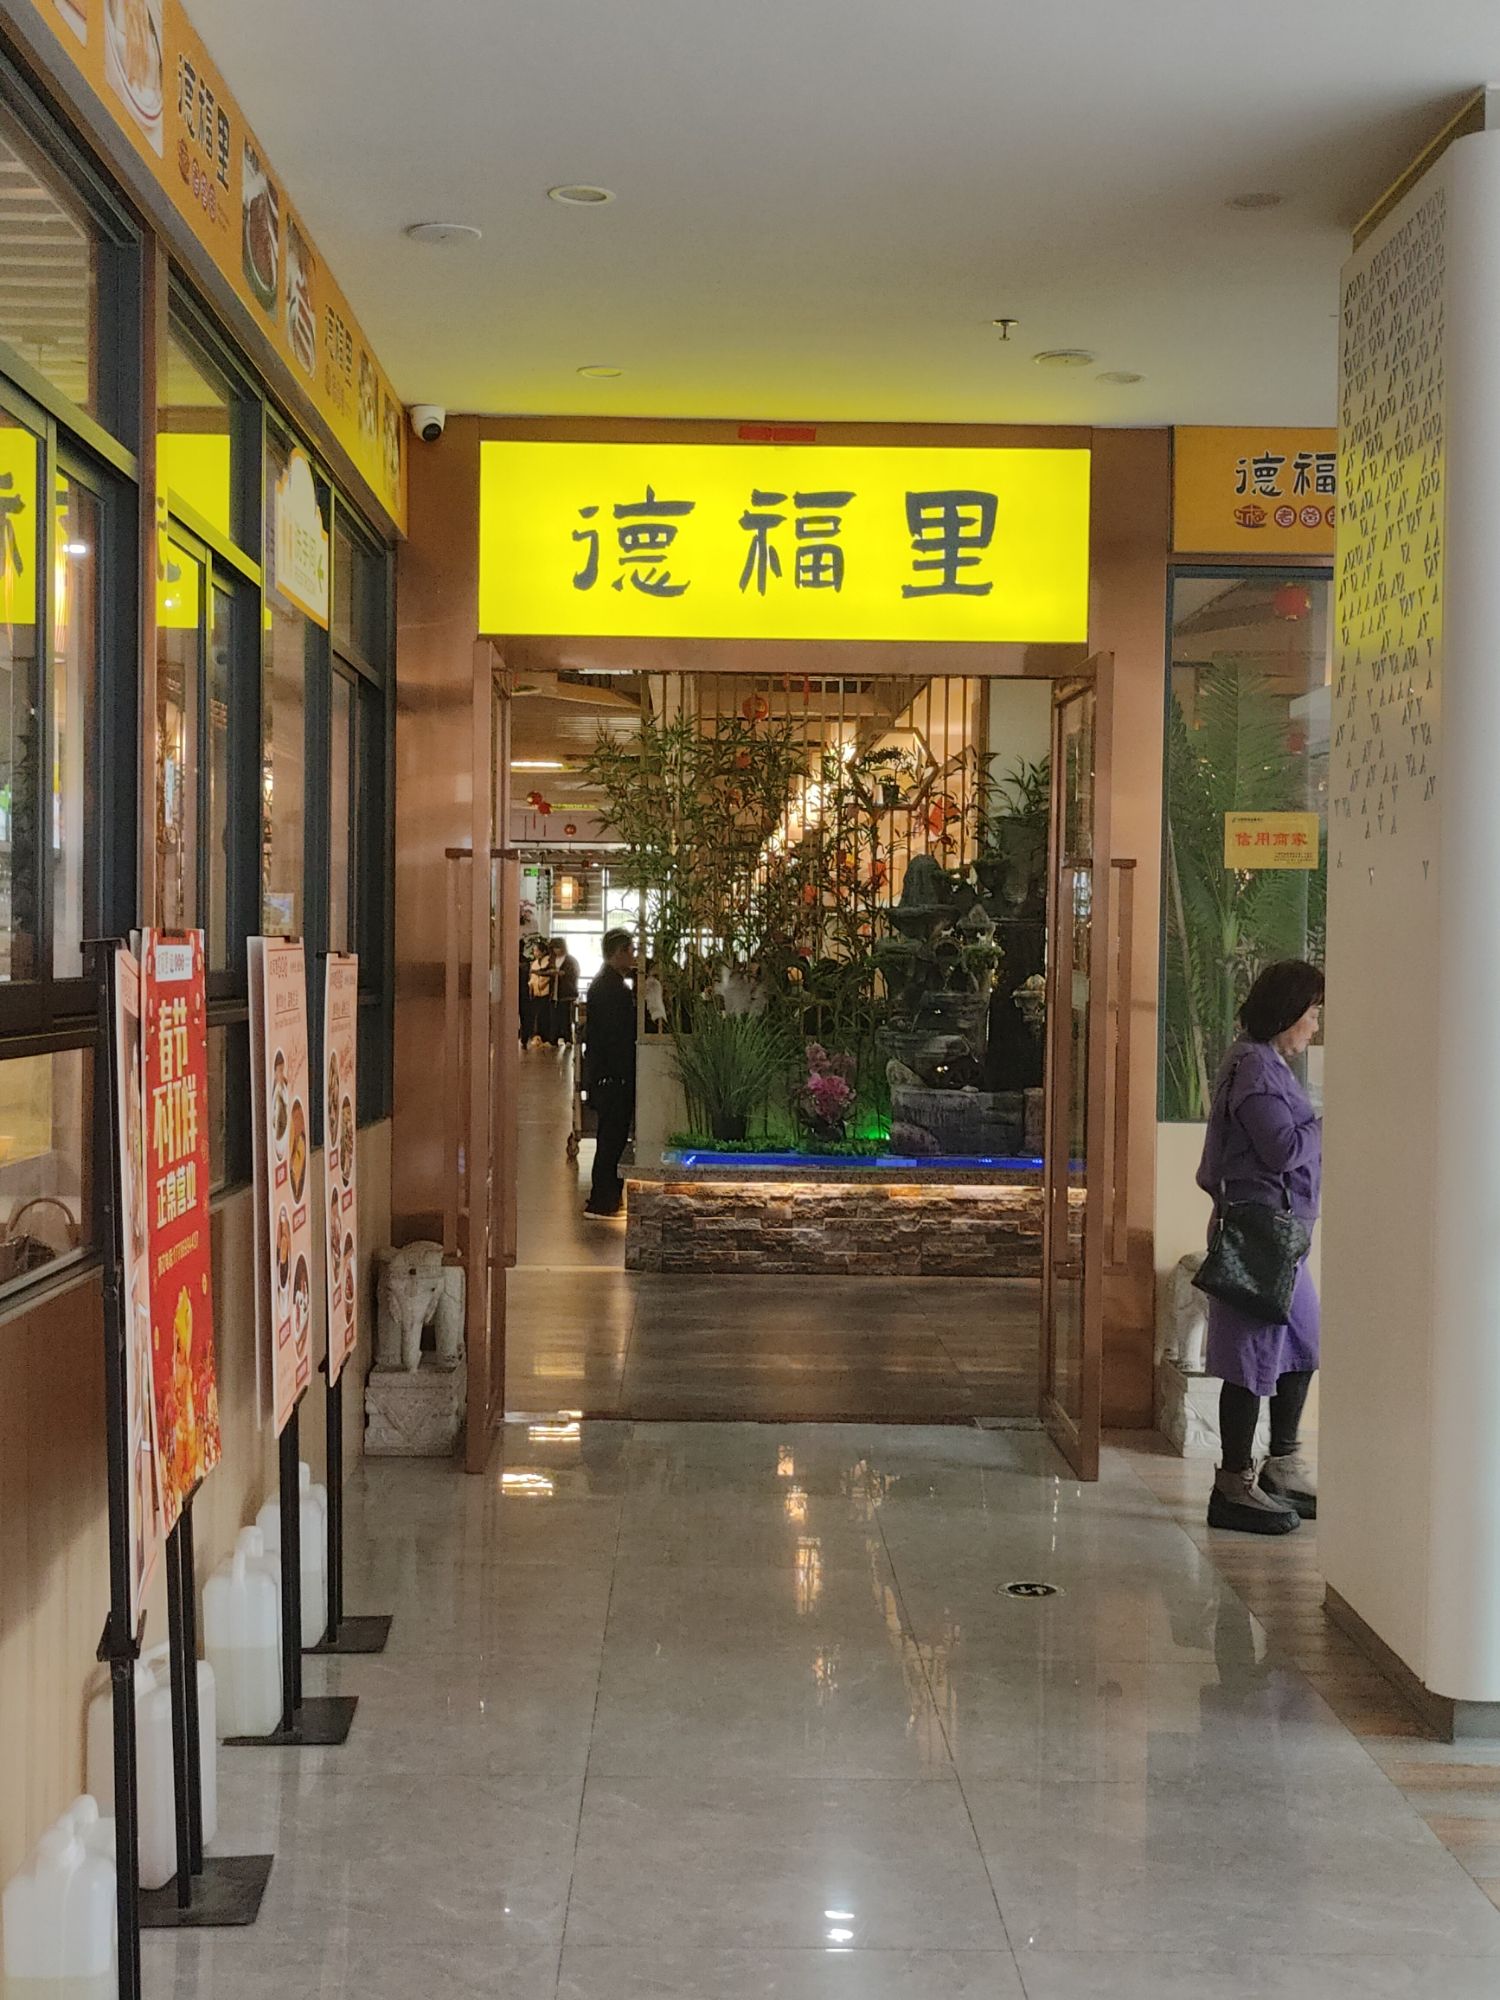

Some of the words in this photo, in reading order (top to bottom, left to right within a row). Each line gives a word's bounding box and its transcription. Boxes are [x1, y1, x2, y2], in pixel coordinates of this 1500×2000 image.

[1235, 451, 1337, 497] 德福
[572, 484, 999, 599] 德福里
[1235, 832, 1308, 847] 信用商家
[158, 997, 189, 1083] 春节
[152, 1073, 197, 1169] 不打烊
[156, 1160, 197, 1230] 正常营业
